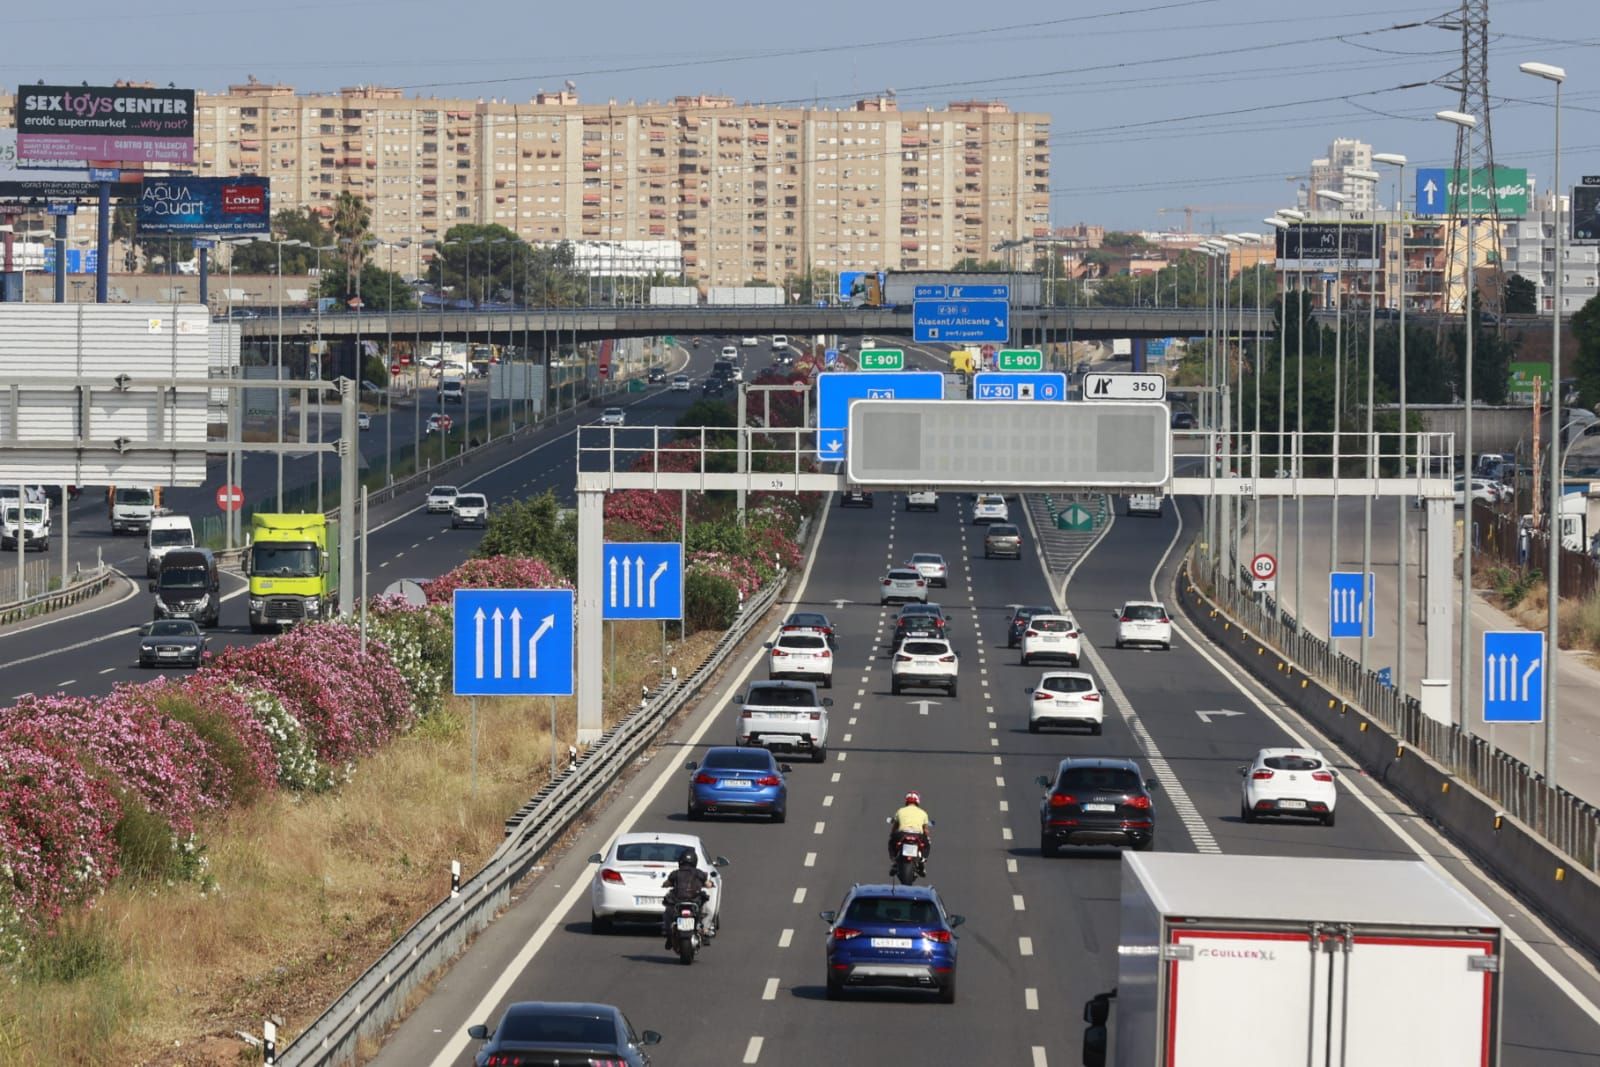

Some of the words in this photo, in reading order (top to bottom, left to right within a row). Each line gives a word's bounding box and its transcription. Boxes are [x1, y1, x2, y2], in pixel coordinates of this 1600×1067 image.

[24, 116, 56, 126] erotic
[58, 118, 127, 128] supermarket
[164, 120, 188, 129] not?
[144, 141, 152, 149] DE
[154, 200, 204, 215] Quart
[865, 355, 898, 365] E-901
[1004, 356, 1037, 366] E-901
[982, 386, 1011, 396] V-30
[1132, 382, 1156, 392] 350
[1256, 562, 1271, 571] 80
